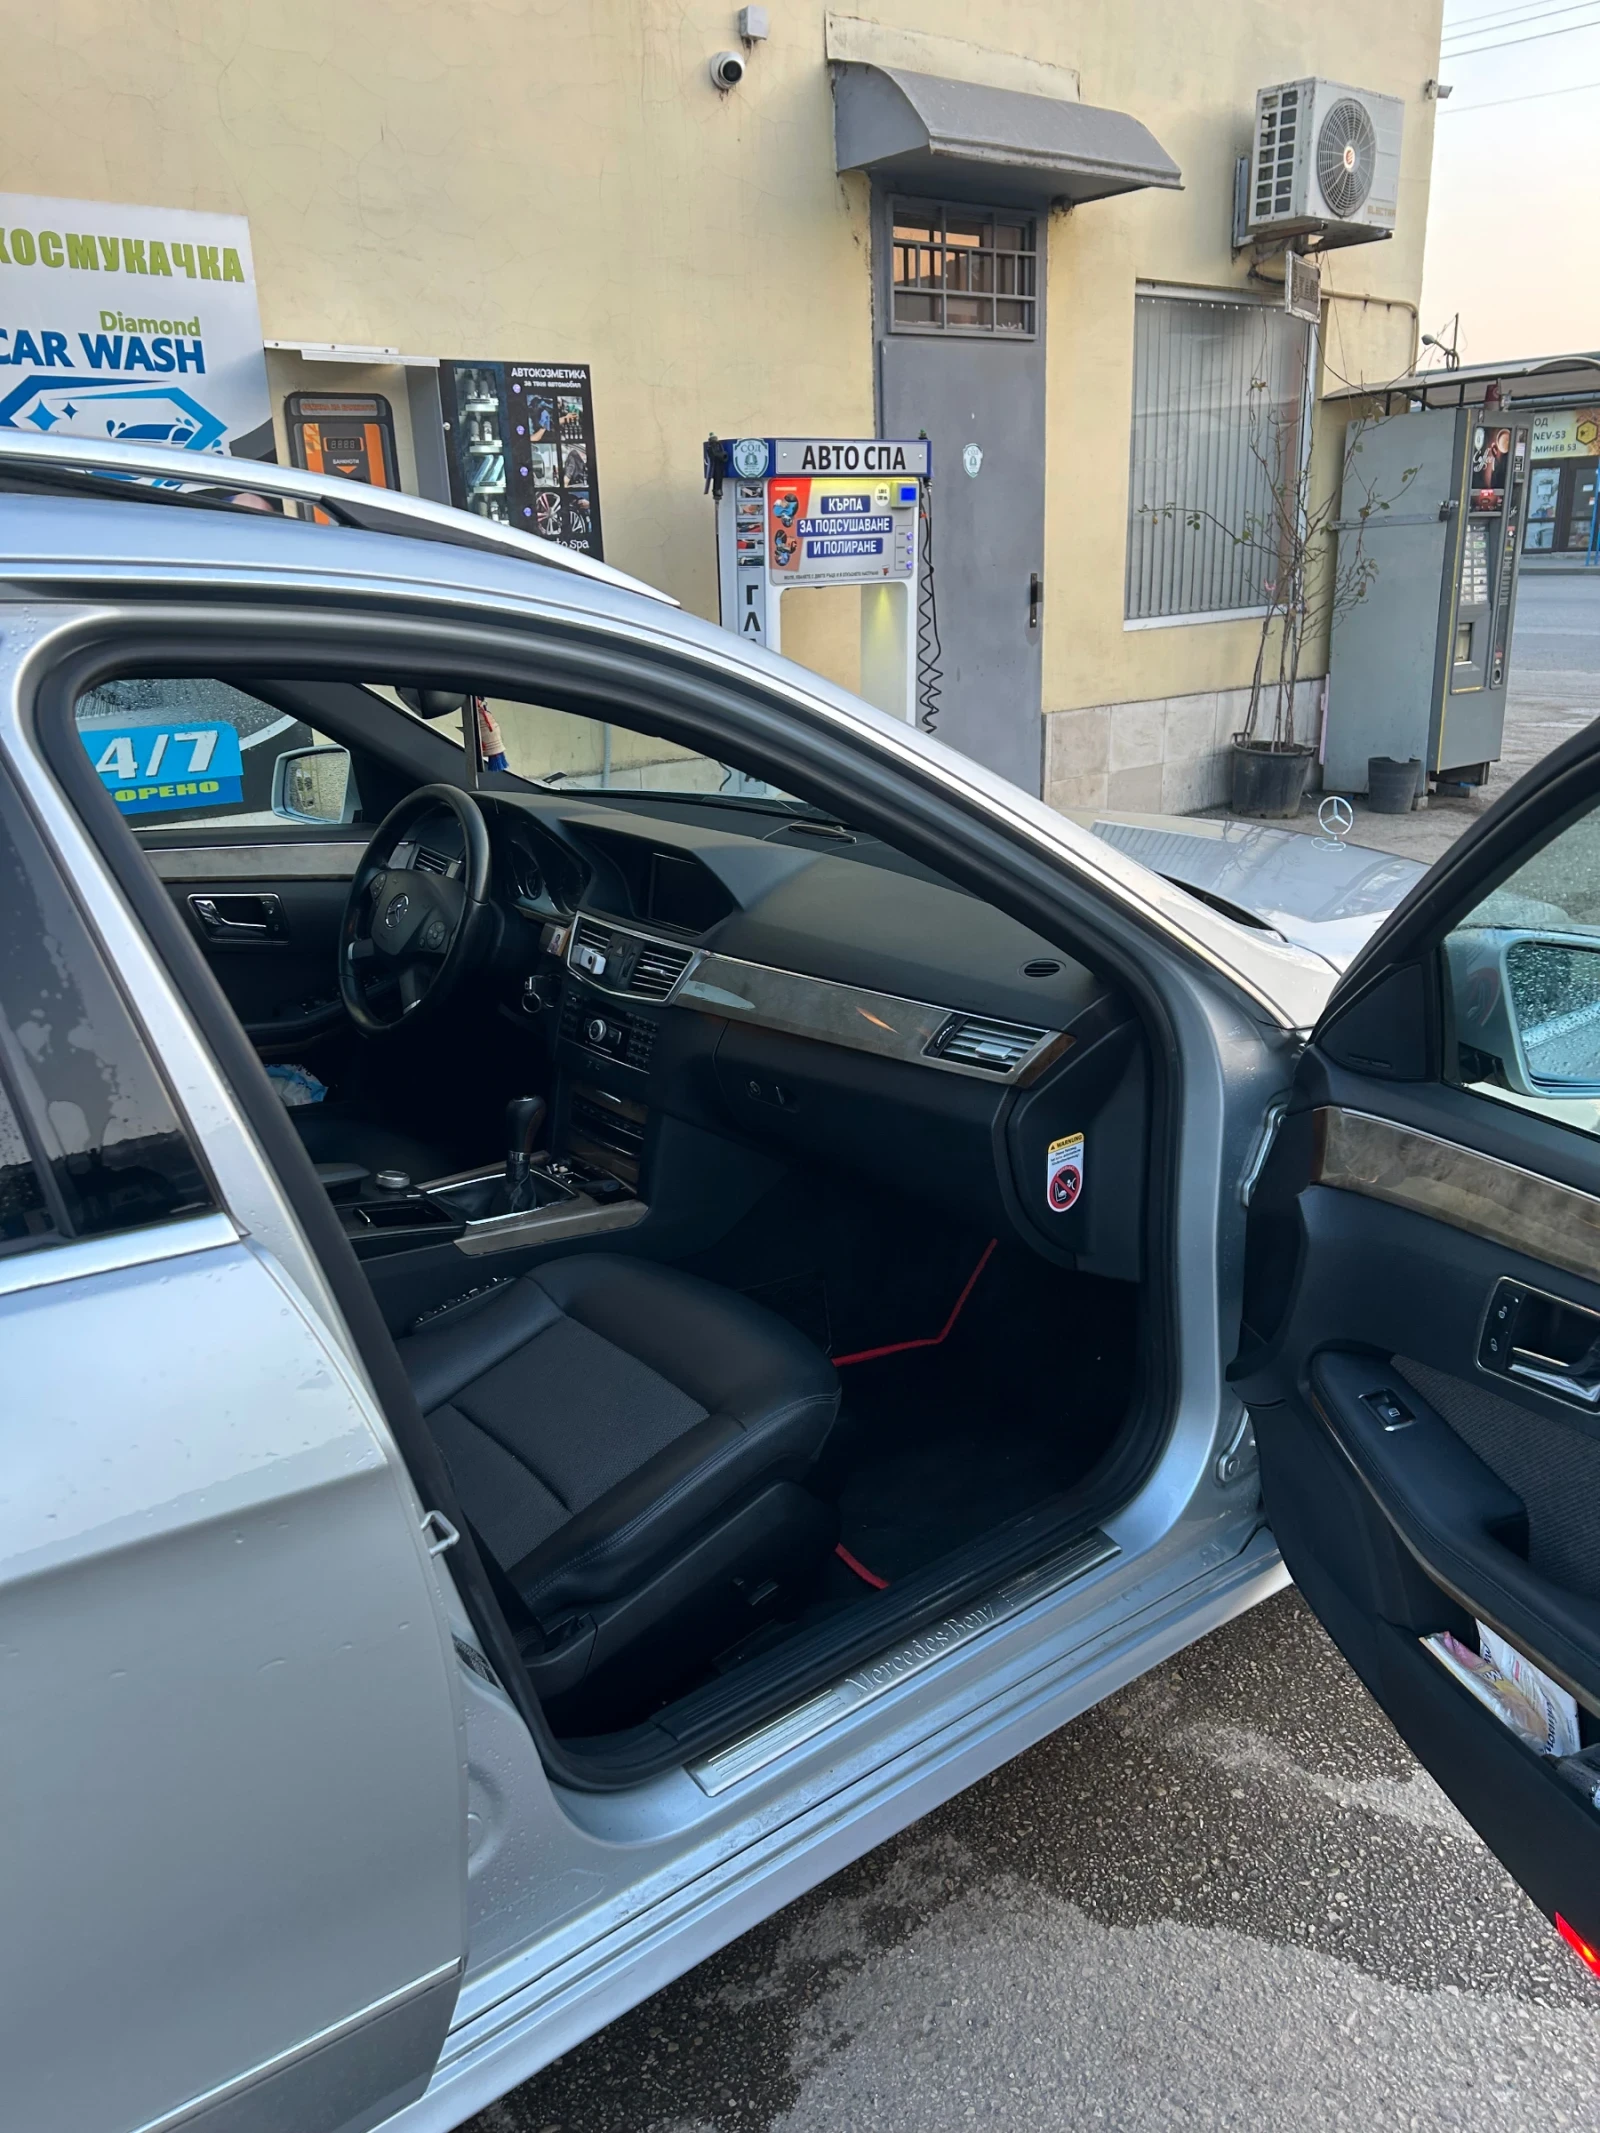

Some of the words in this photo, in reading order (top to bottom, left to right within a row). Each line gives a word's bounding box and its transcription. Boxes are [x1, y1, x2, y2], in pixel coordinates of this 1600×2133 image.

[100, 310, 201, 337] Diamond
[79, 333, 206, 374] WASH
[511, 367, 586, 379] АВТОКОЗМЕТИКА
[1567, 443, 1577, 451] 53
[802, 445, 859, 470] АВТО
[864, 446, 906, 470] СПА
[828, 497, 863, 512] КЪРПА
[799, 519, 813, 533] ЗА
[816, 517, 890, 535] ПОДСУШАВАНЕ
[569, 539, 589, 552] spa
[813, 542, 821, 554] И
[823, 540, 877, 554] ПОЛИРАНЕ
[110, 781, 219, 802] ОРЕНО
